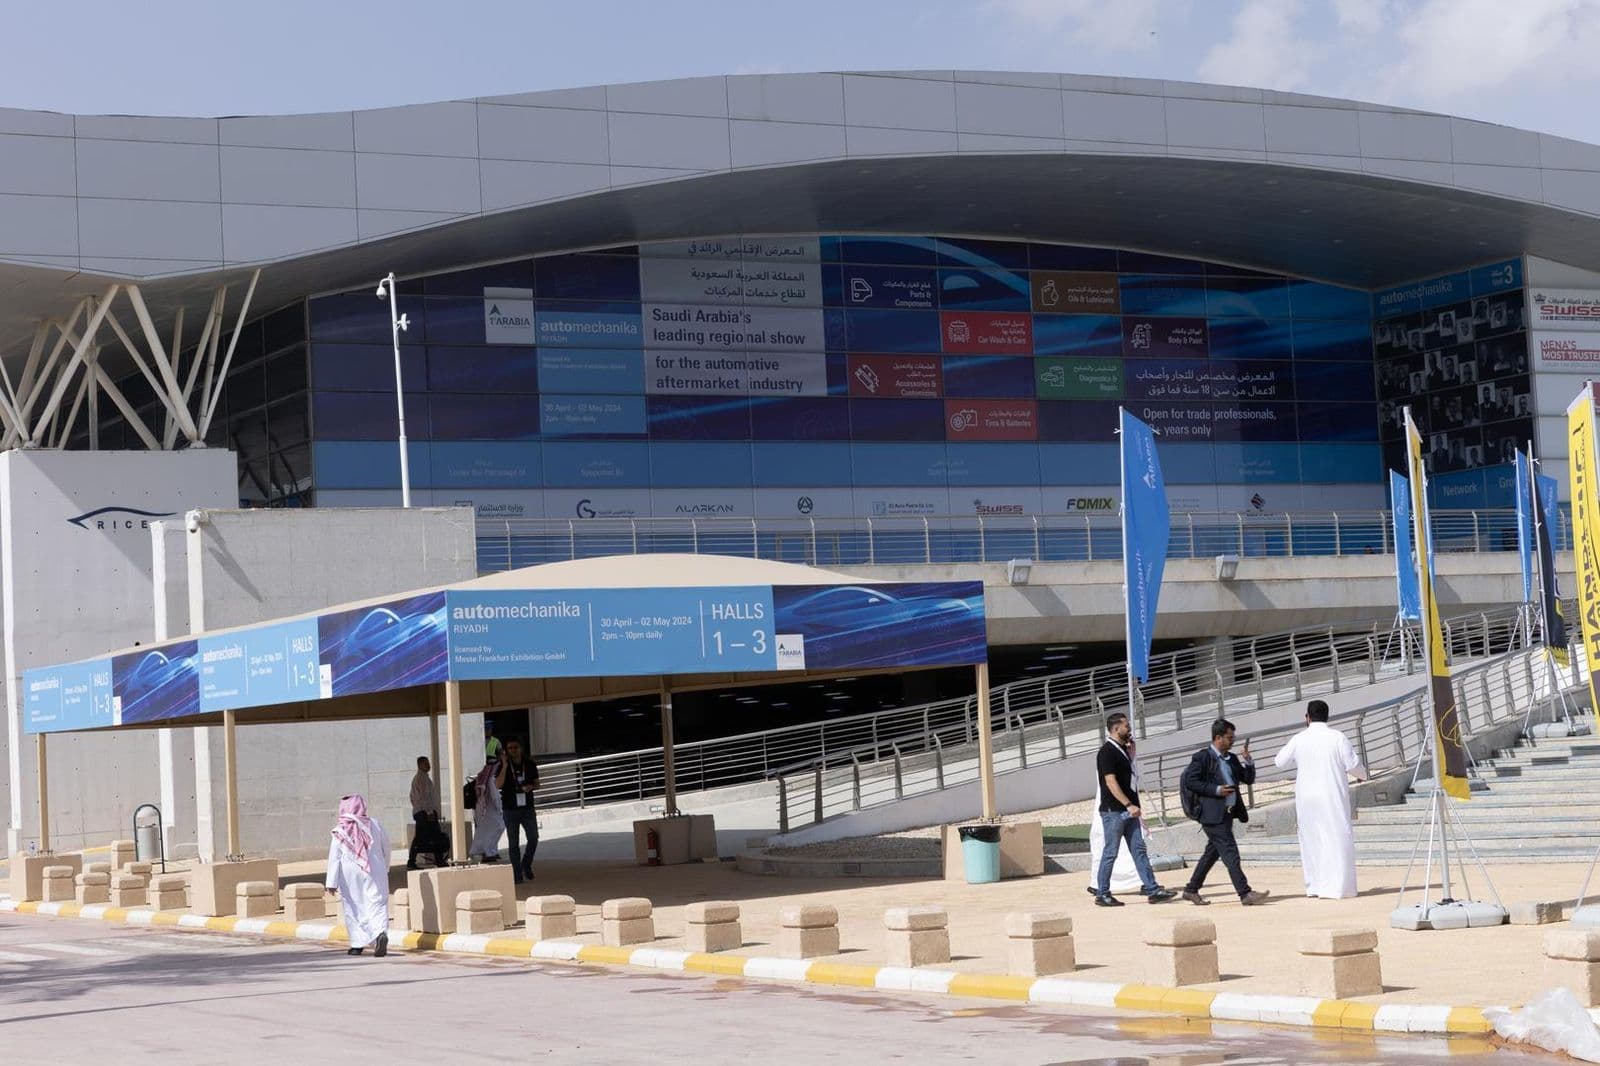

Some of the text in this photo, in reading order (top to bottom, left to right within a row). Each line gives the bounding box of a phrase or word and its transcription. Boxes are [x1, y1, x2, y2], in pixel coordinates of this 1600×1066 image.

[691, 267, 805, 282] المملكة العربية السعودية
[1503, 265, 1514, 284] 3
[704, 286, 806, 303] لقطاع خدمات المركبات
[652, 308, 752, 324] Saudi Arabia's
[541, 320, 638, 335] automechanika
[653, 328, 806, 346] leading regional show
[655, 355, 780, 372] for the automotive
[1569, 350, 1600, 361] TRUSTE
[656, 376, 803, 393] aftermarket industry
[1201, 384, 1210, 394] 18
[1143, 408, 1277, 422] Open for trade professionals,
[1164, 426, 1190, 437] years
[1191, 424, 1211, 437] only
[1443, 483, 1479, 496] Network
[1066, 498, 1112, 511] FOMIX
[453, 602, 582, 619] automechanika
[712, 602, 765, 620] HALLS
[453, 624, 489, 635] RIYADH
[601, 618, 611, 628] 30
[613, 616, 632, 630] April
[641, 617, 651, 627] 02
[654, 616, 671, 629] May
[673, 616, 693, 626] 2024
[601, 631, 618, 642] 2pm
[625, 630, 645, 642] 10pm
[646, 629, 664, 641] daily
[713, 630, 723, 656] 1
[753, 630, 768, 655] 3
[291, 637, 313, 655] HALLS
[293, 662, 298, 687] 1
[307, 661, 315, 685] 3
[105, 693, 111, 713] 3
